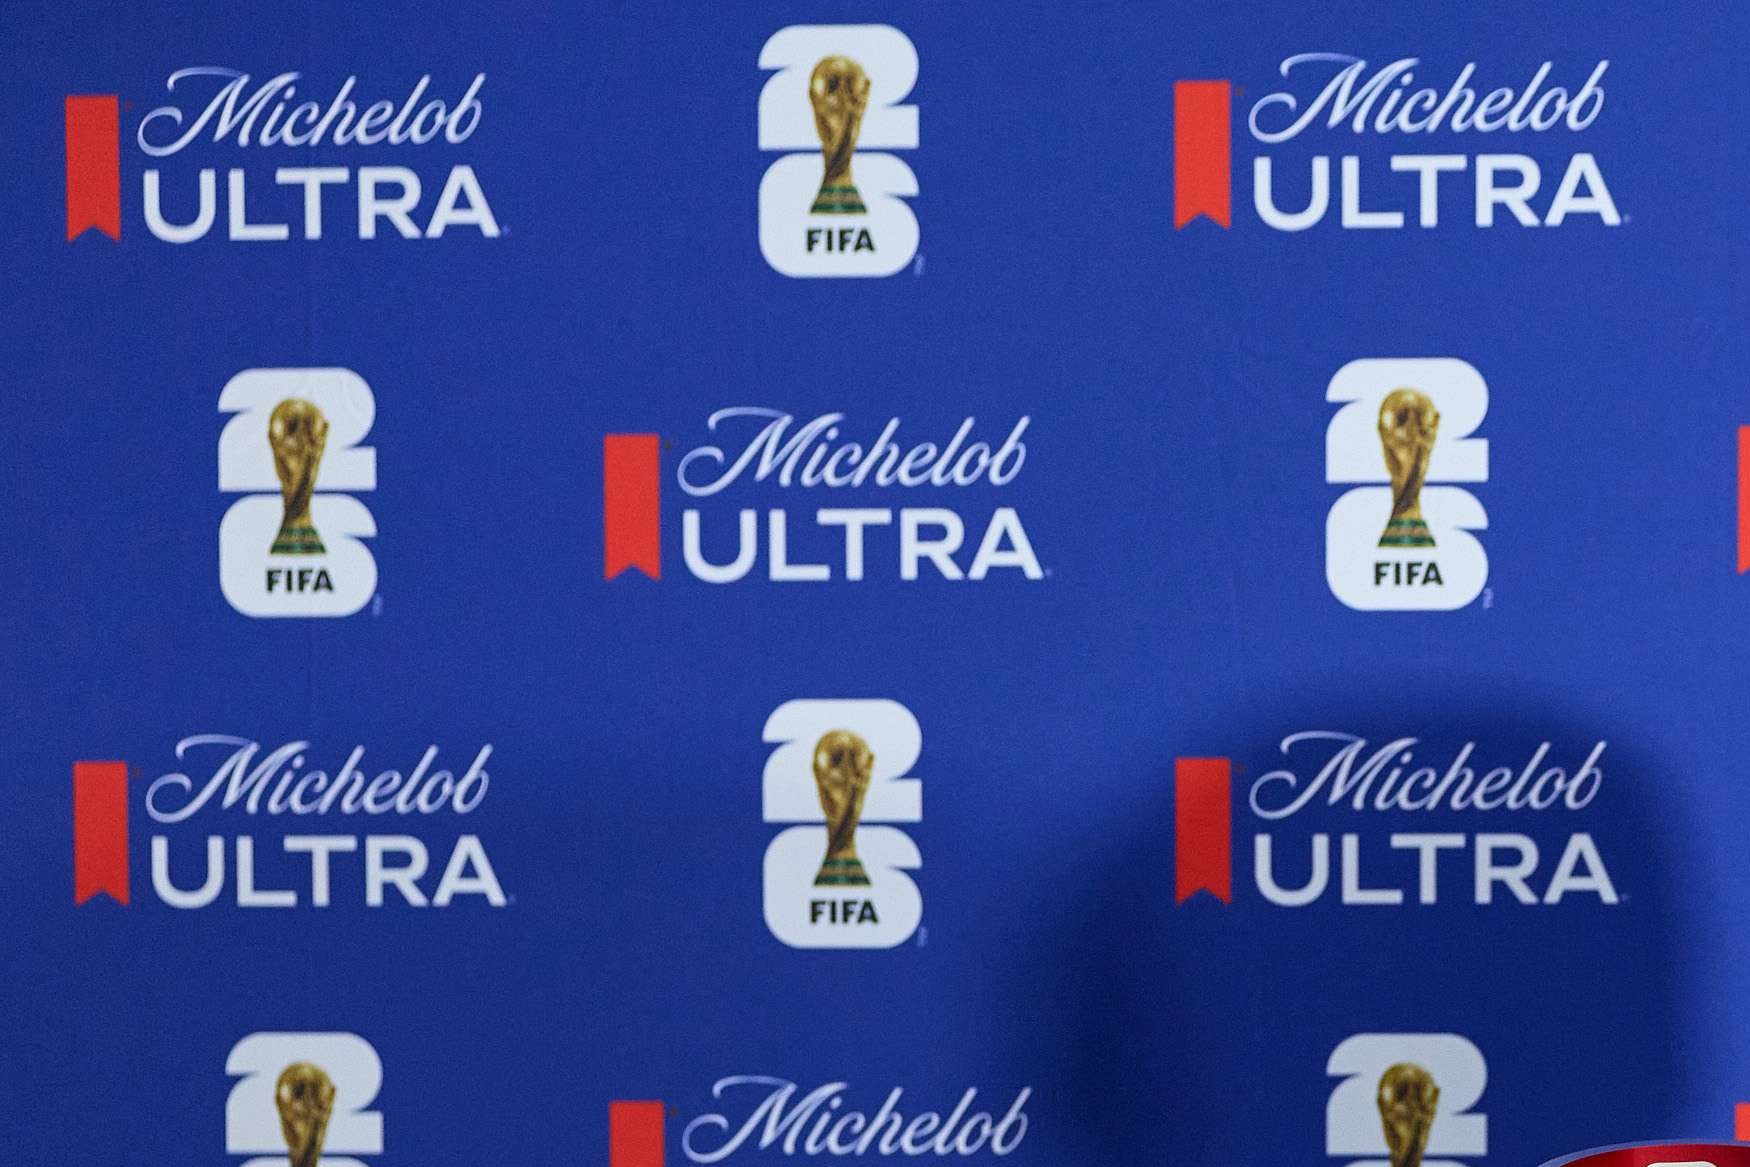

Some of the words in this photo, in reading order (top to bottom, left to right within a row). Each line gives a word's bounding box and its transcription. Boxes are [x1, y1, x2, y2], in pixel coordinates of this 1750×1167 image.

[138, 69, 485, 156] Michelob
[1249, 54, 1608, 143] Michelob
[144, 165, 500, 243] ULTRA
[1254, 153, 1621, 231] ULTRA
[806, 228, 875, 253] FIFA
[678, 408, 1029, 496] Michelob
[266, 568, 334, 593] FIFA
[683, 508, 1043, 583] ULTRA
[1374, 561, 1444, 586] FIFA
[146, 735, 492, 822] Michelob
[1250, 731, 1606, 819] Michelob
[152, 835, 506, 908] ULTRA
[1255, 833, 1618, 906] ULTRA
[810, 900, 879, 924] FIFA
[683, 1076, 1030, 1163] Michelob
